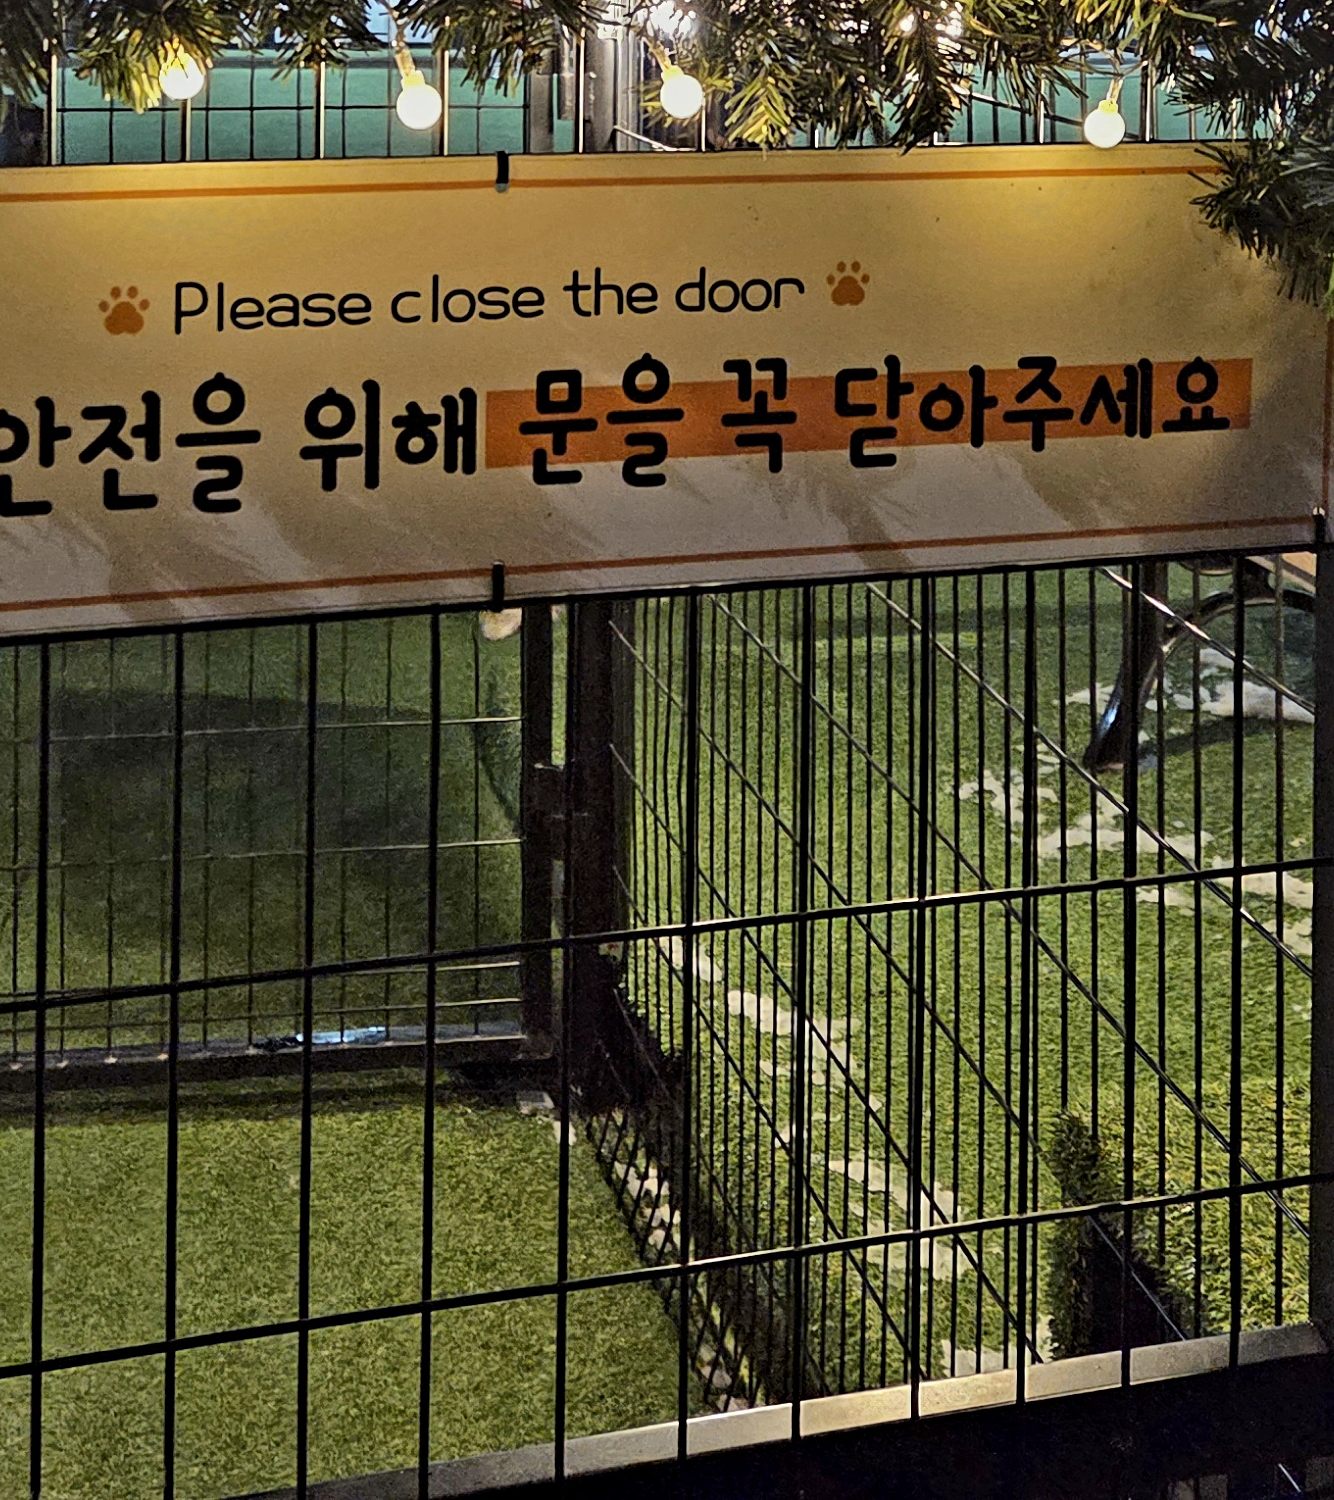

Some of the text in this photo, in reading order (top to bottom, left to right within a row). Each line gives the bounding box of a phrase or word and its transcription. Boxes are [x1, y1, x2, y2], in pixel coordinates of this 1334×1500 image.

[173, 265, 806, 336] Please close the door
[299, 378, 479, 494] 위해
[516, 352, 686, 489] 문을
[719, 356, 799, 475] 꼭
[832, 353, 1233, 470] 닫아주세요
